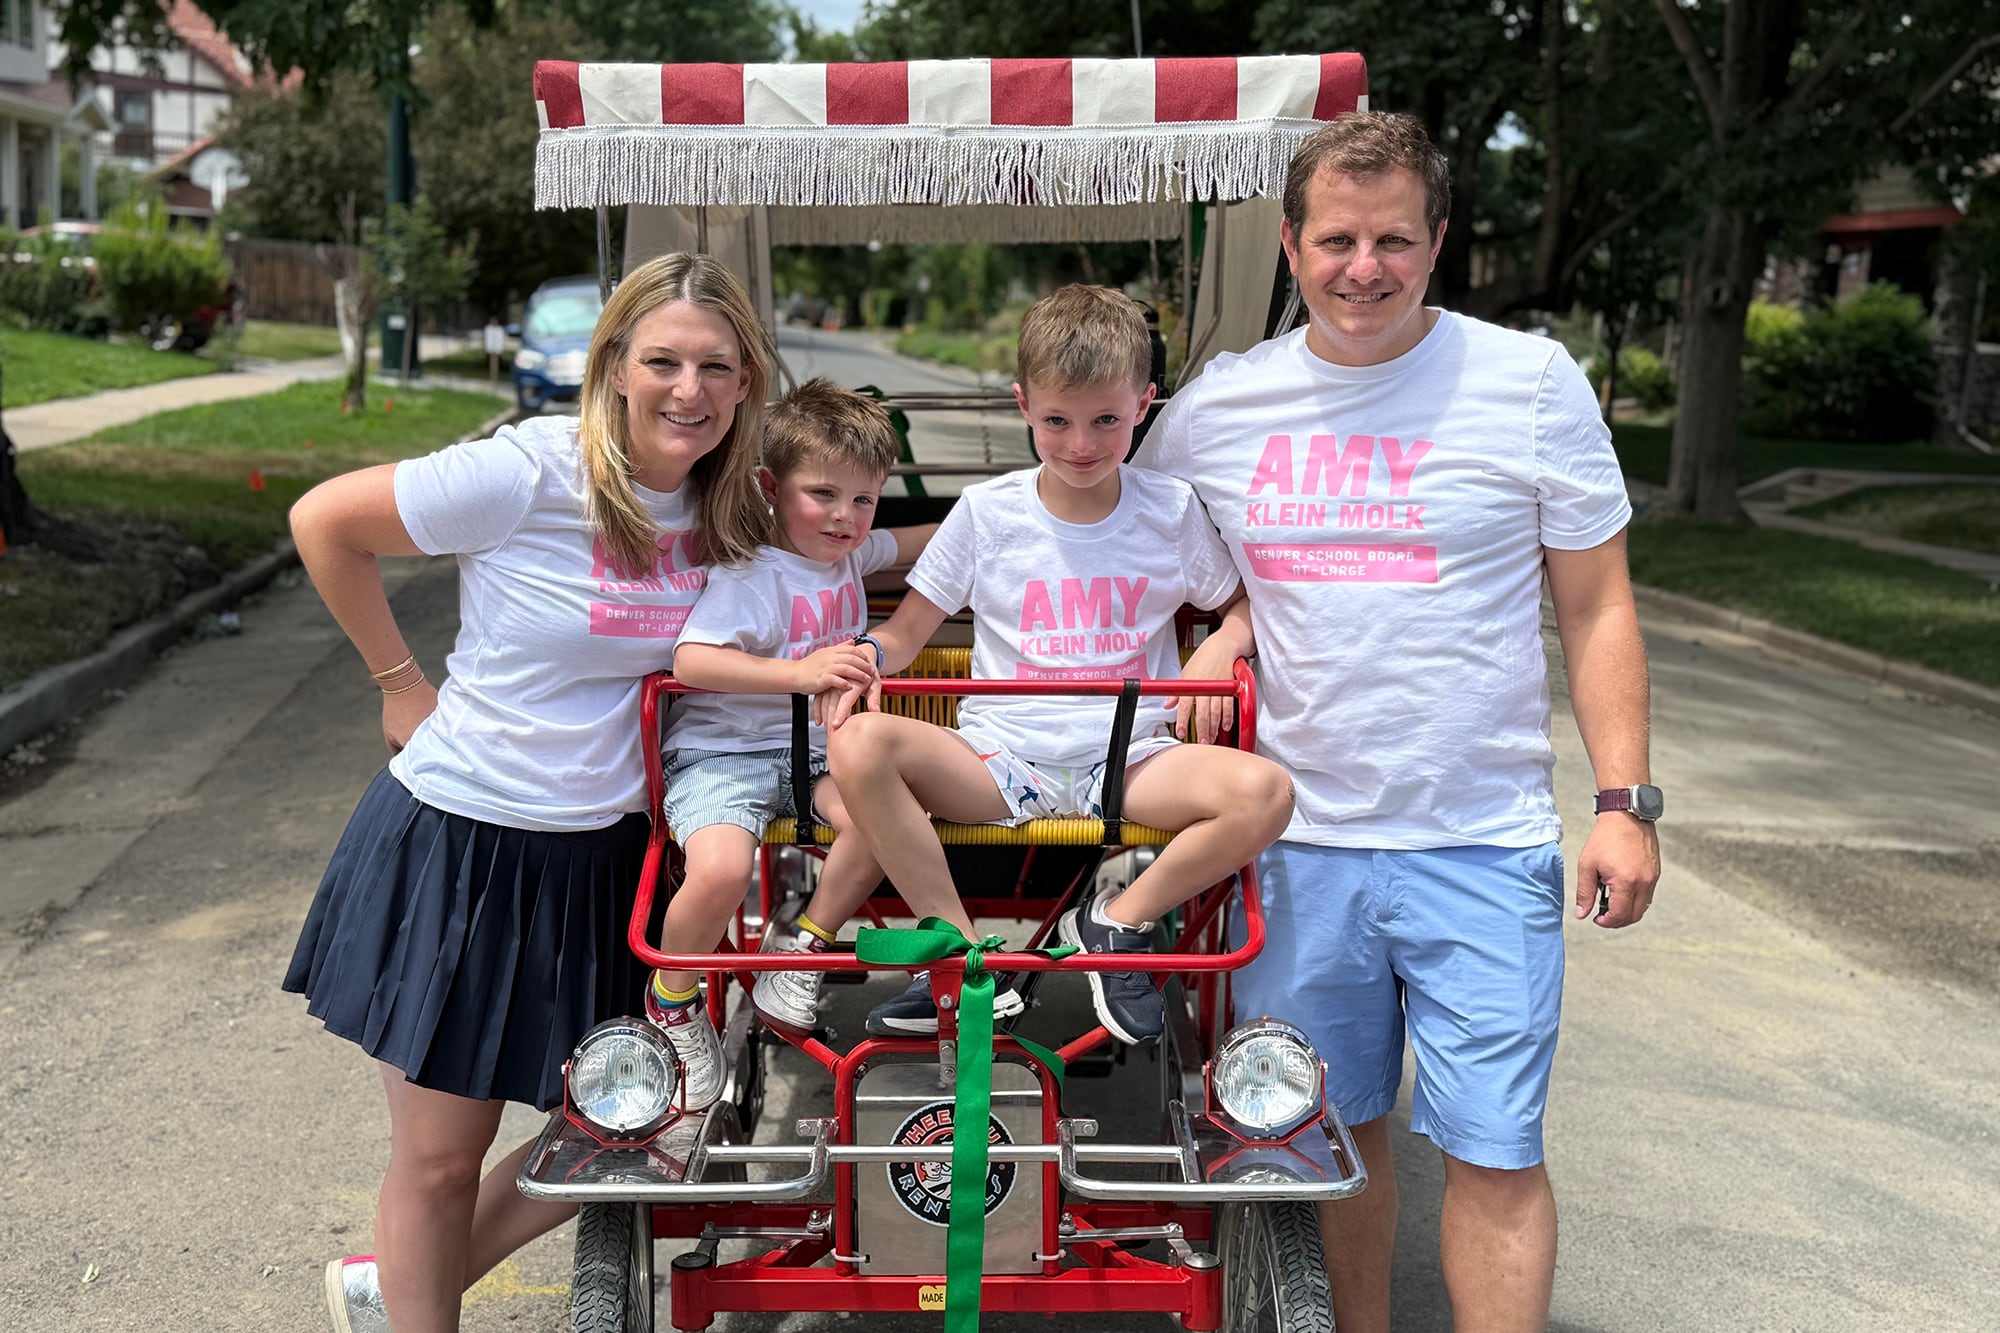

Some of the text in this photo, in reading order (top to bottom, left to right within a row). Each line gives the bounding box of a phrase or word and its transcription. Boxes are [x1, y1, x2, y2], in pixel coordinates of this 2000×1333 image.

[1246, 434, 1434, 497] AMY
[1246, 503, 1427, 530] KLEIN MOLK
[1255, 550, 1415, 562] DENVER SCHOOL BOARD
[671, 569, 708, 592] MO
[1292, 565, 1367, 576] AT-LARGE
[606, 609, 646, 619] DENVER
[789, 582, 859, 643] AMY
[1019, 576, 1150, 632] AMY
[638, 623, 683, 633] AT-LAR
[1020, 631, 1148, 656] KLEIN MOLK
[1027, 670, 1069, 680] DENVER
[1072, 671, 1112, 680] SCHOOL
[901, 1109, 953, 1146] HEE
[898, 1173, 1003, 1217] RENS
[921, 1293, 944, 1303] MADE
